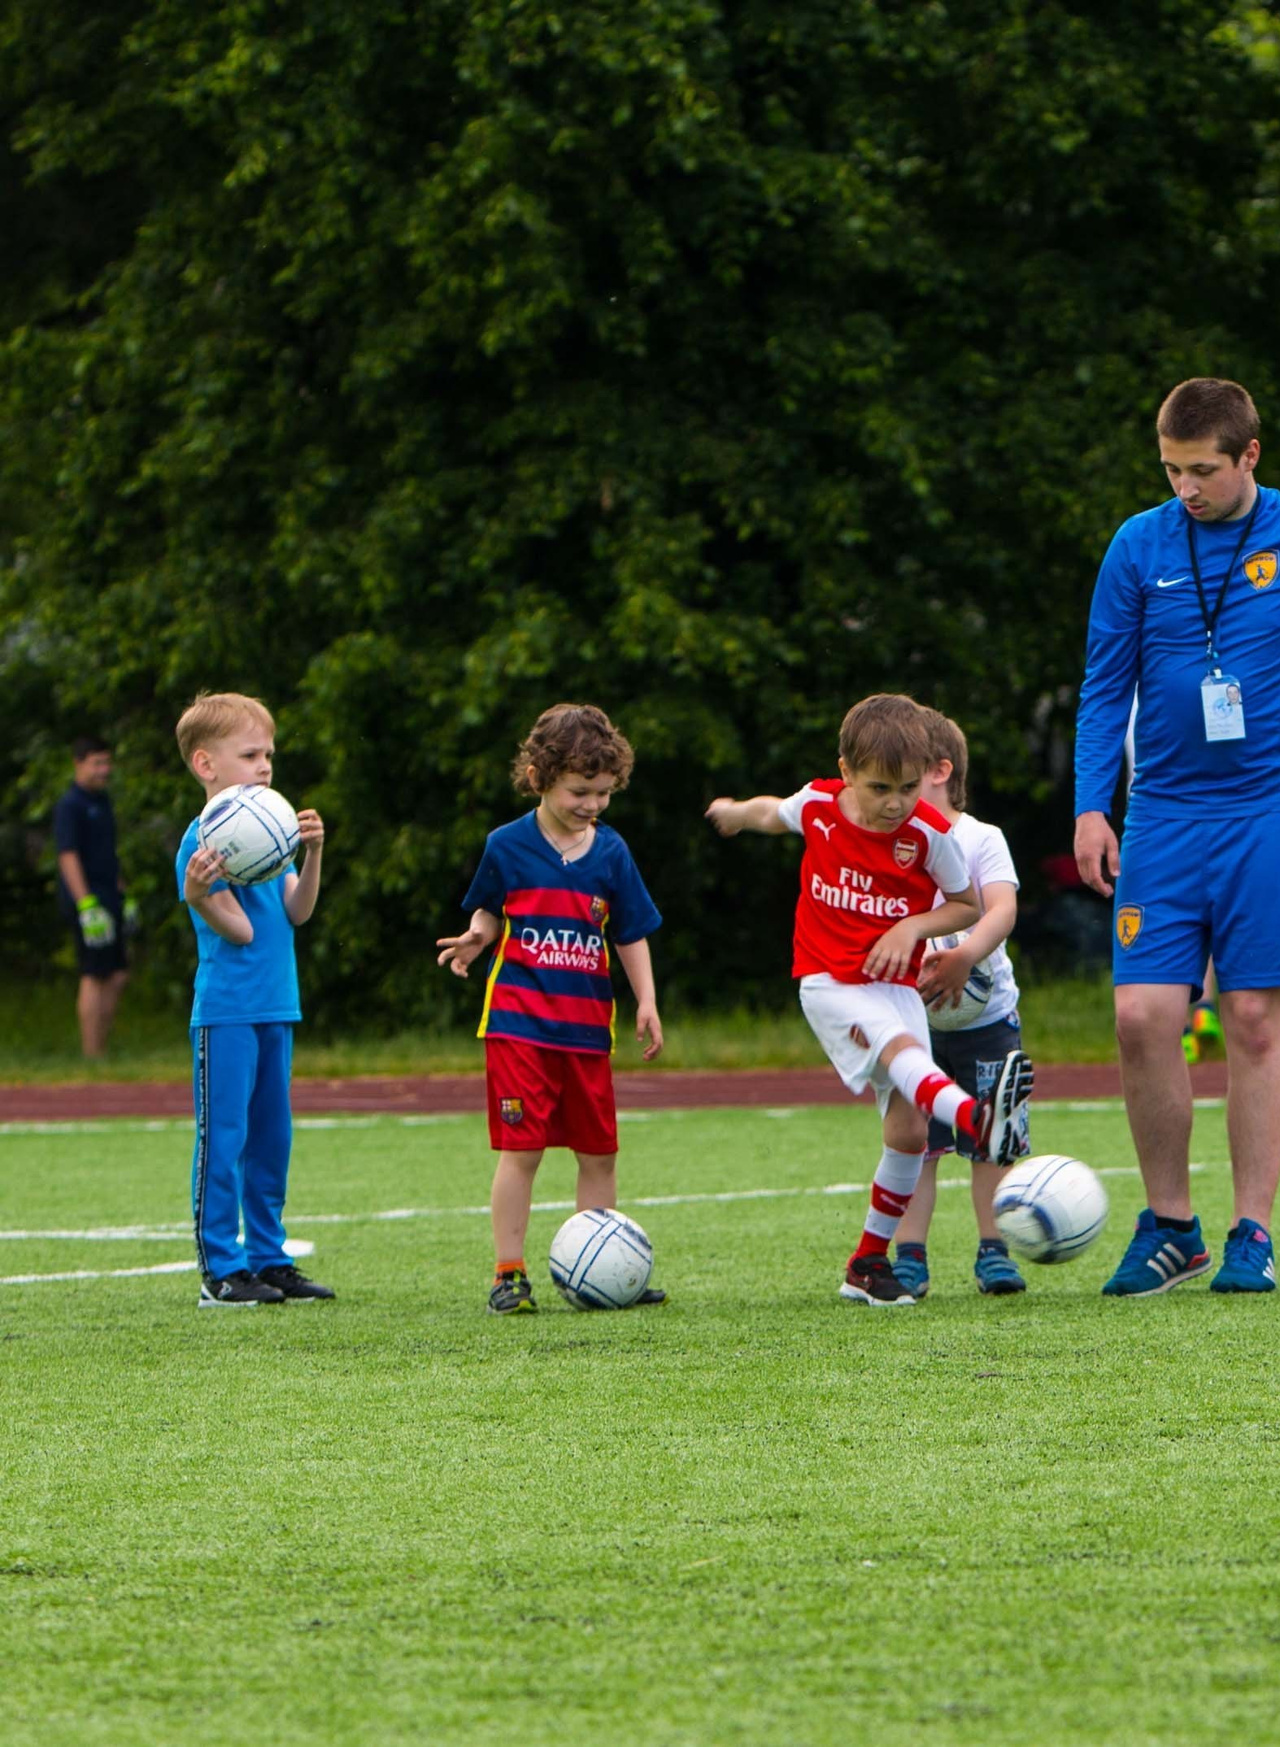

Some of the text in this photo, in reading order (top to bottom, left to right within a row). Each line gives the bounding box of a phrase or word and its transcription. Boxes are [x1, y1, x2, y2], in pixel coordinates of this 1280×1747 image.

[839, 866, 873, 892] Fly
[811, 873, 909, 917] Emirates
[521, 927, 601, 956] QATAR
